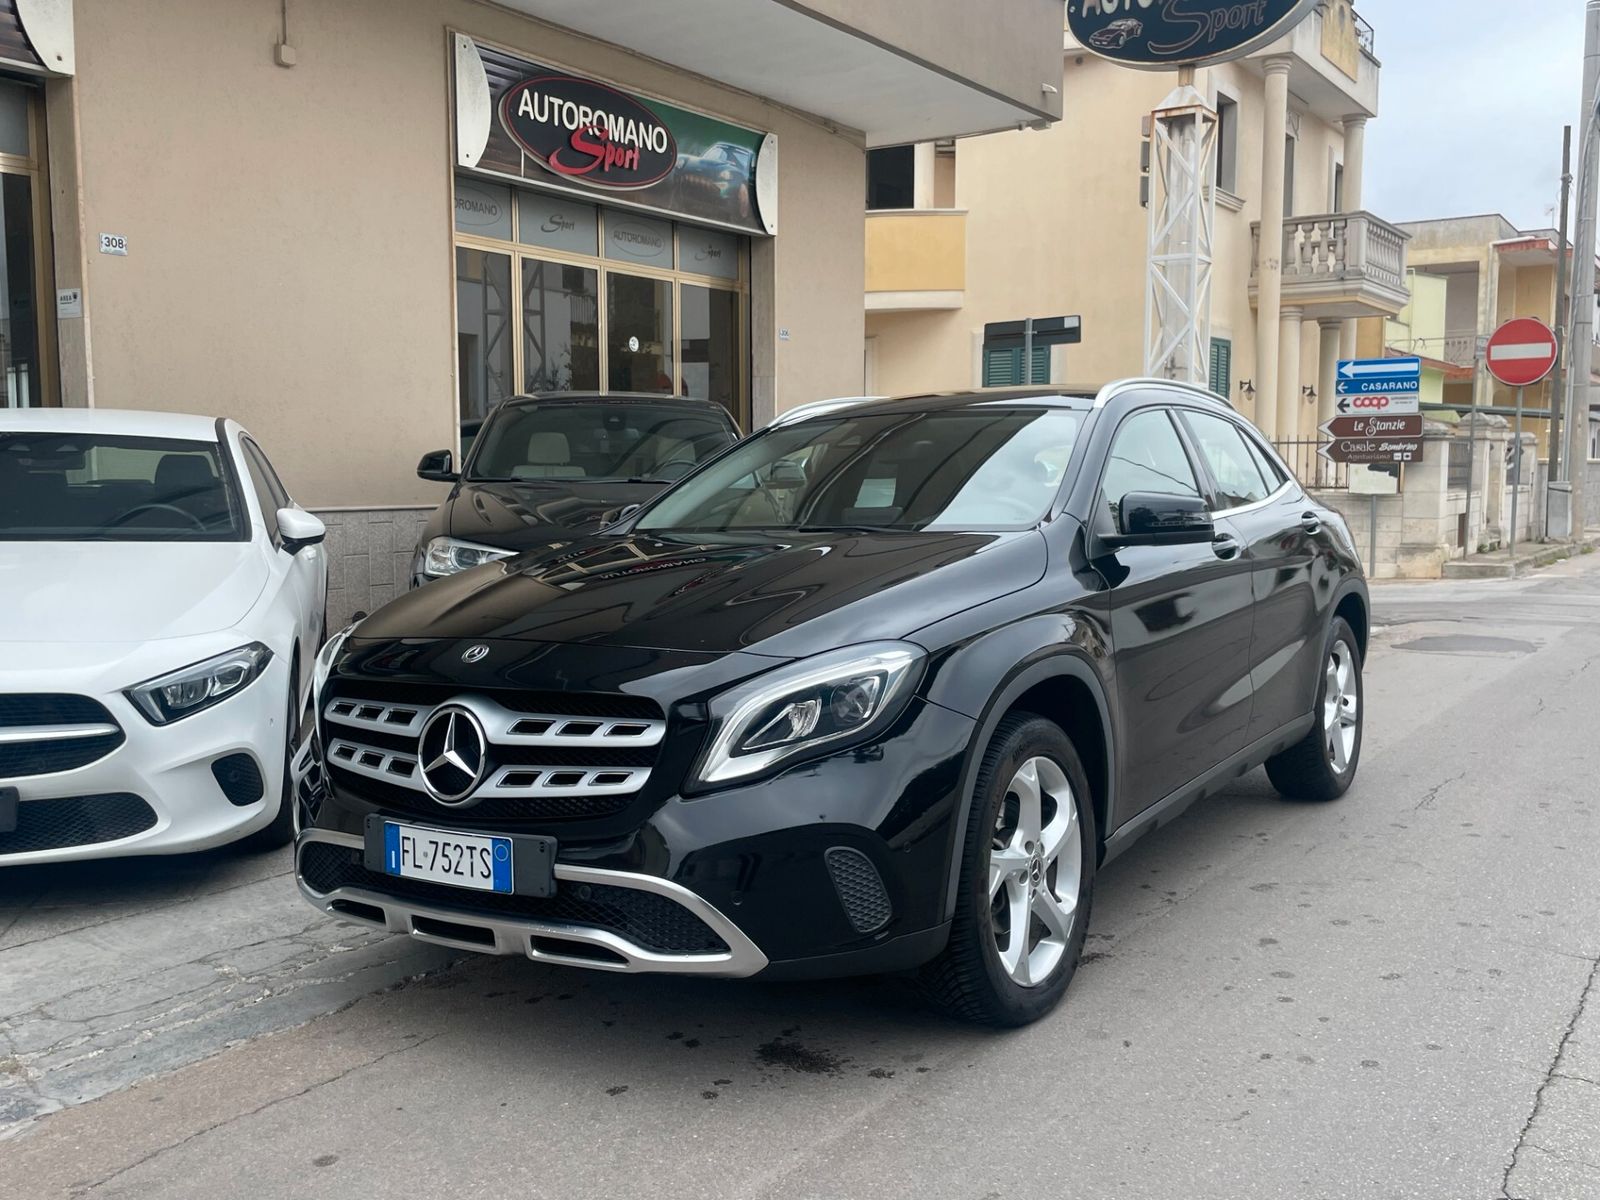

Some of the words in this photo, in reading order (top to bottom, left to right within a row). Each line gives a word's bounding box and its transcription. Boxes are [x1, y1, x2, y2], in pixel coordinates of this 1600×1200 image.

[518, 88, 668, 153] AUTOROMANO
[549, 125, 640, 175] Sport
[104, 236, 124, 249] 308
[1361, 381, 1418, 392] CASARANO
[1352, 396, 1390, 410] coop
[1353, 420, 1364, 432] Le
[1365, 416, 1406, 437] Stanzie
[1340, 441, 1376, 452] Casale
